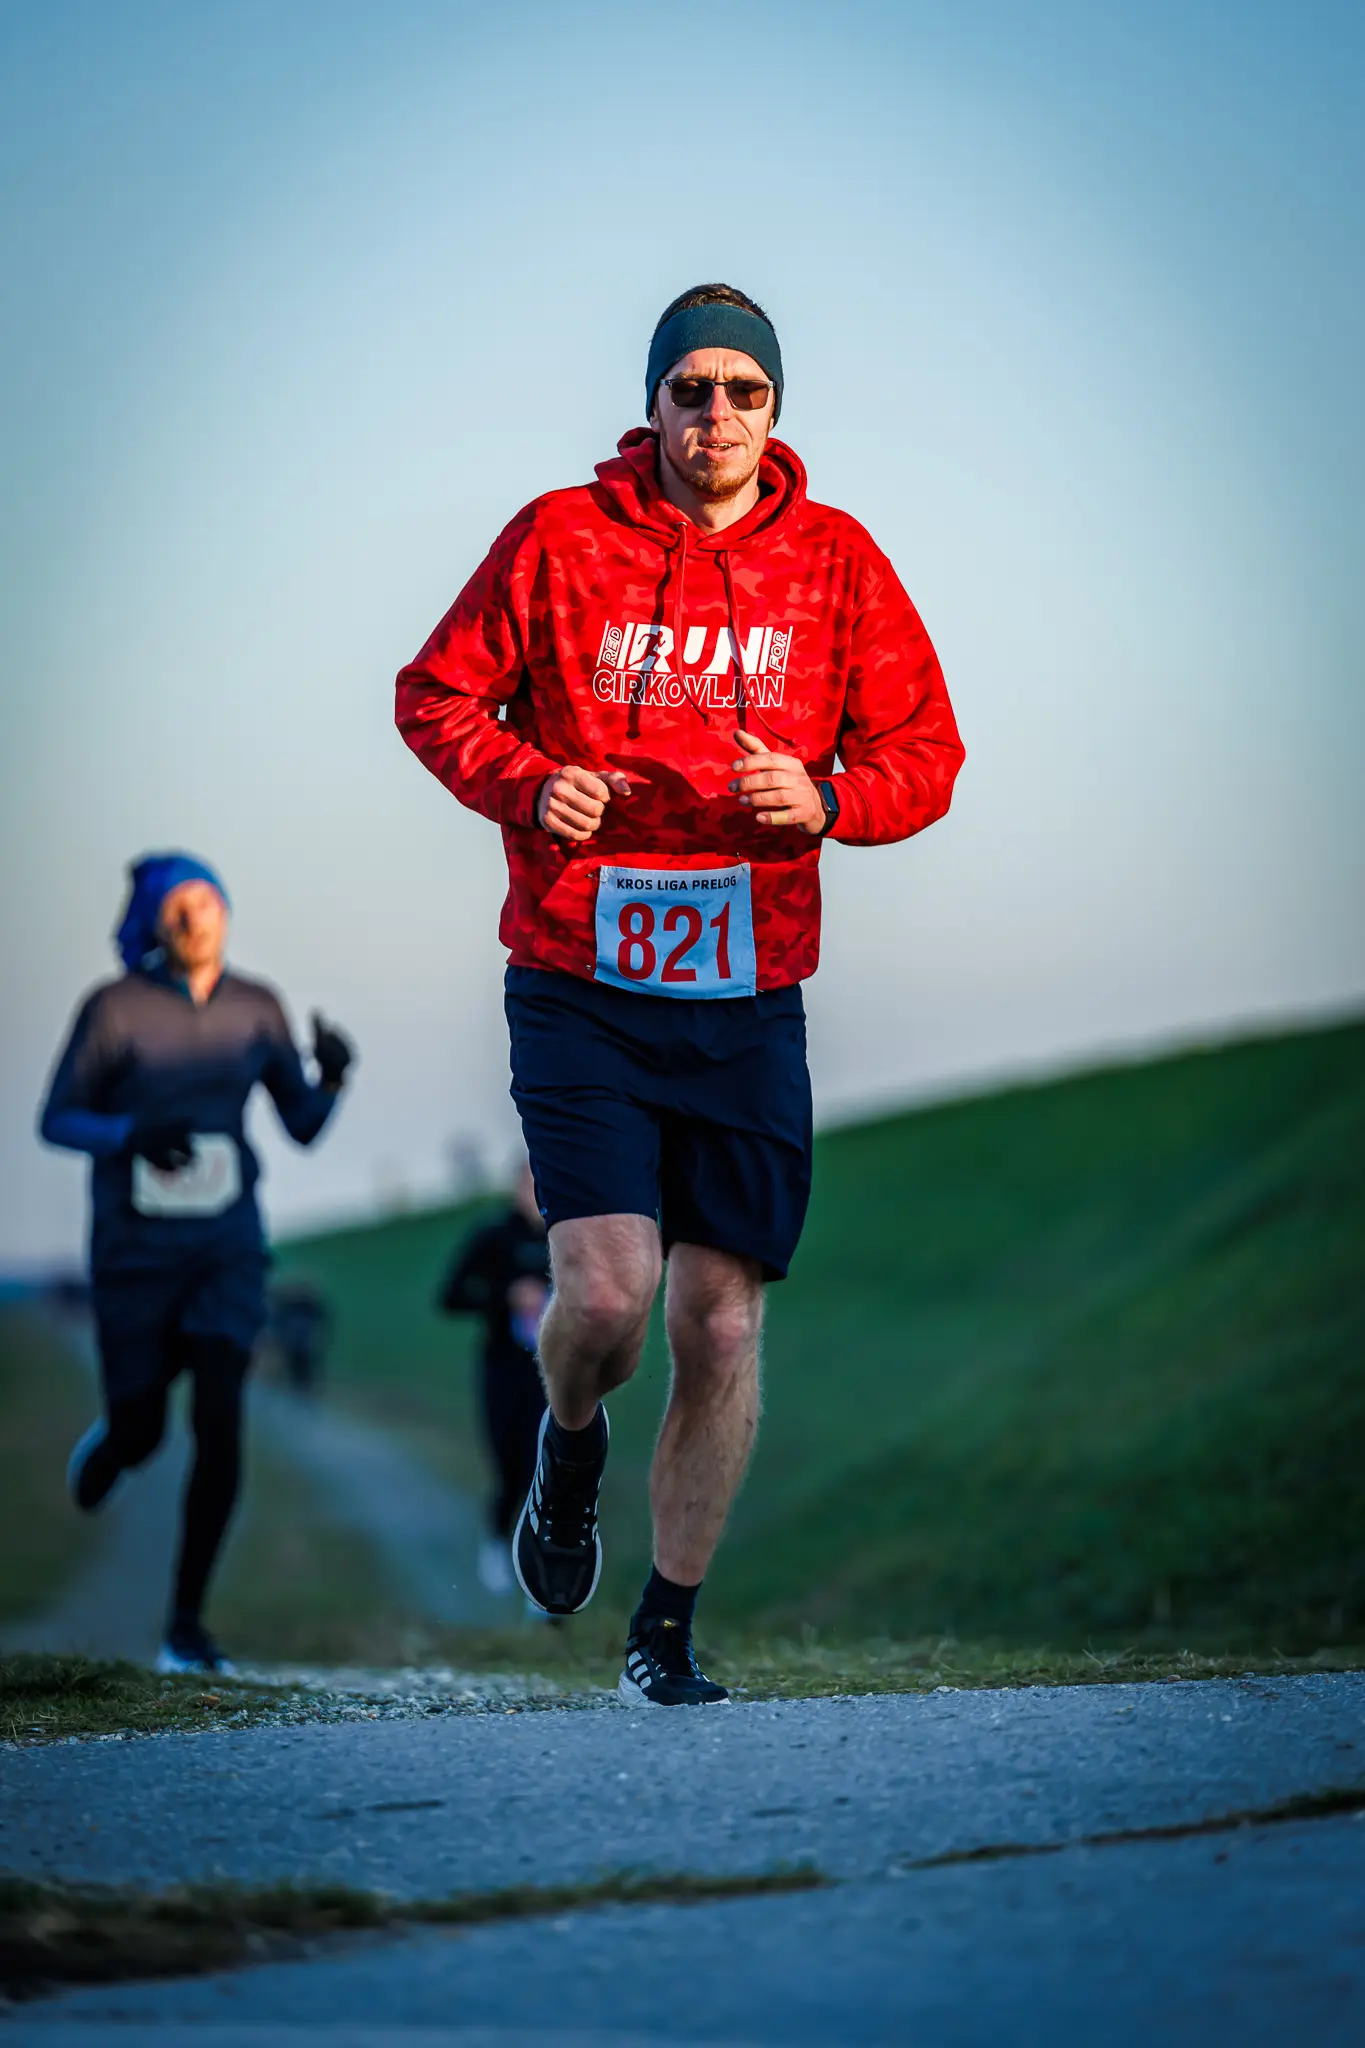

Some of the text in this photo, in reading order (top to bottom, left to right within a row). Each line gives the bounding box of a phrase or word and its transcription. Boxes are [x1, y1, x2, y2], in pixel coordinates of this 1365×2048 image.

[602, 626, 622, 667] RED
[628, 624, 764, 674] RUN
[768, 630, 788, 672] FOR
[593, 669, 785, 708] CIRKOVLJAN
[617, 875, 737, 891] KROS LIGA PRELOG
[617, 901, 732, 982] 821
